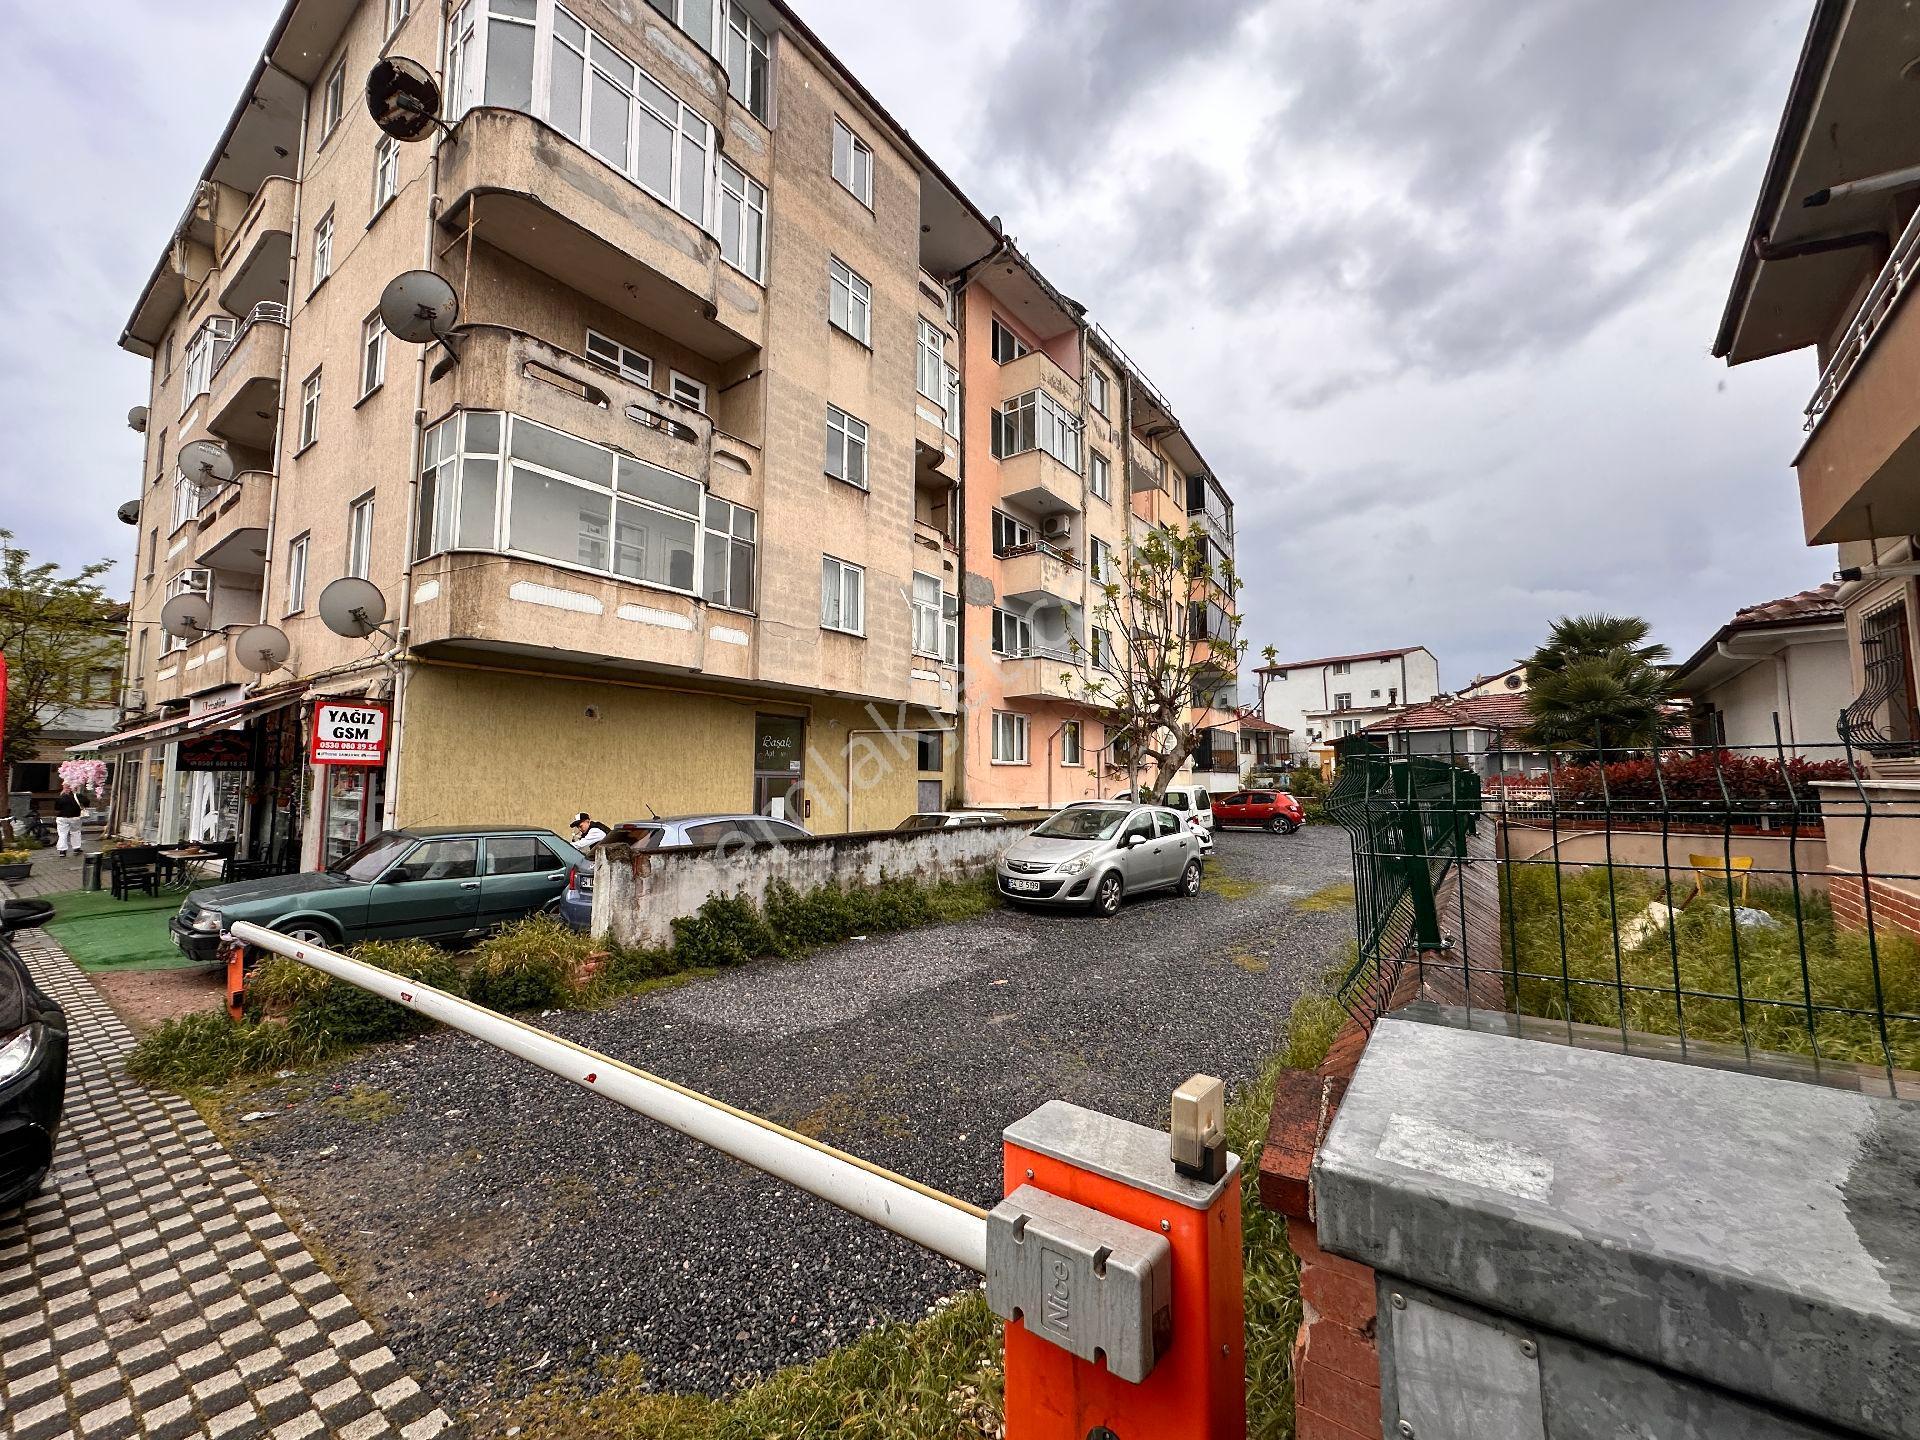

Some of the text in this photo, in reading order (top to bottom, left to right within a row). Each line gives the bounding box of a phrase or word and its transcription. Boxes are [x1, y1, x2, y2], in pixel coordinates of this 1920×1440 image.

[328, 709, 376, 725] YAĞIZ
[332, 726, 369, 740] GSM
[1047, 1259, 1071, 1331] Nice
